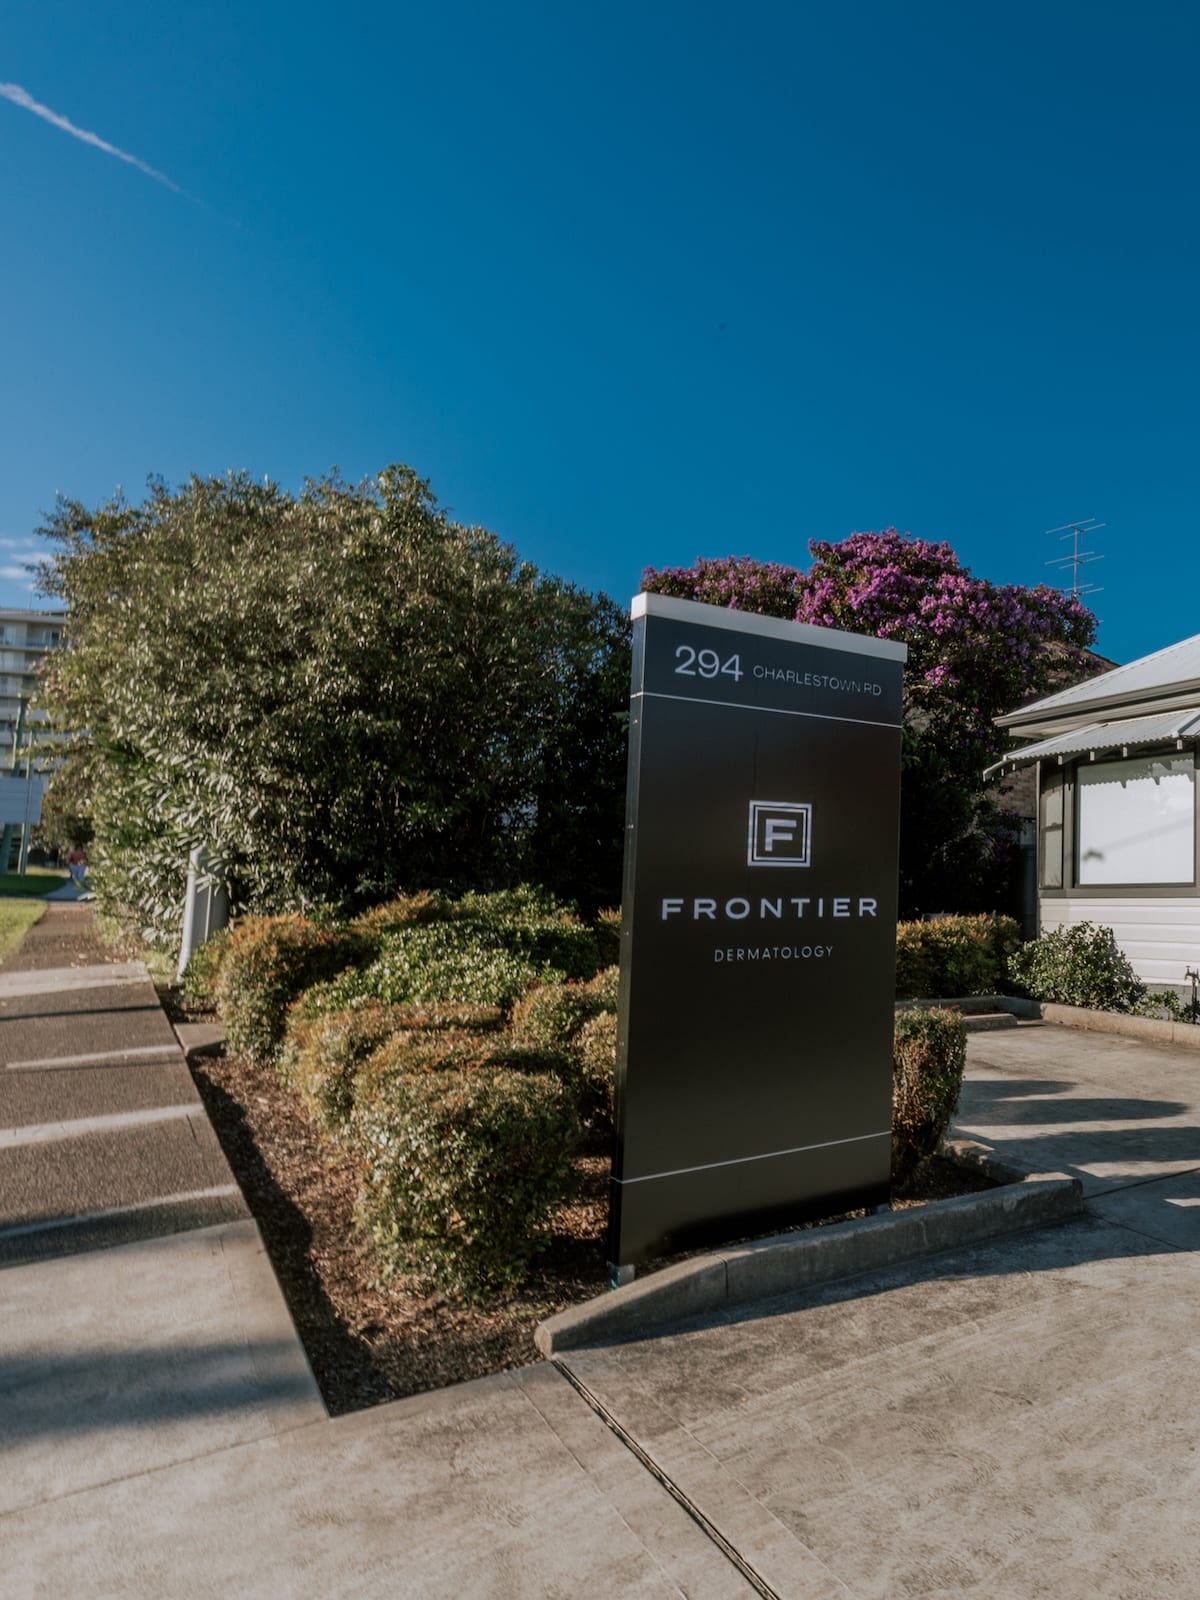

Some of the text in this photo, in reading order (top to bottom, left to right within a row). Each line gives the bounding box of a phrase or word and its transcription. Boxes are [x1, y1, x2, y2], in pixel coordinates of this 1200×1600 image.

[675, 646, 882, 696] 294 CHARLESTOWN RD
[764, 819, 797, 852] F
[662, 897, 877, 920] FRONTIER
[714, 946, 833, 962] DERMATOLOGY
